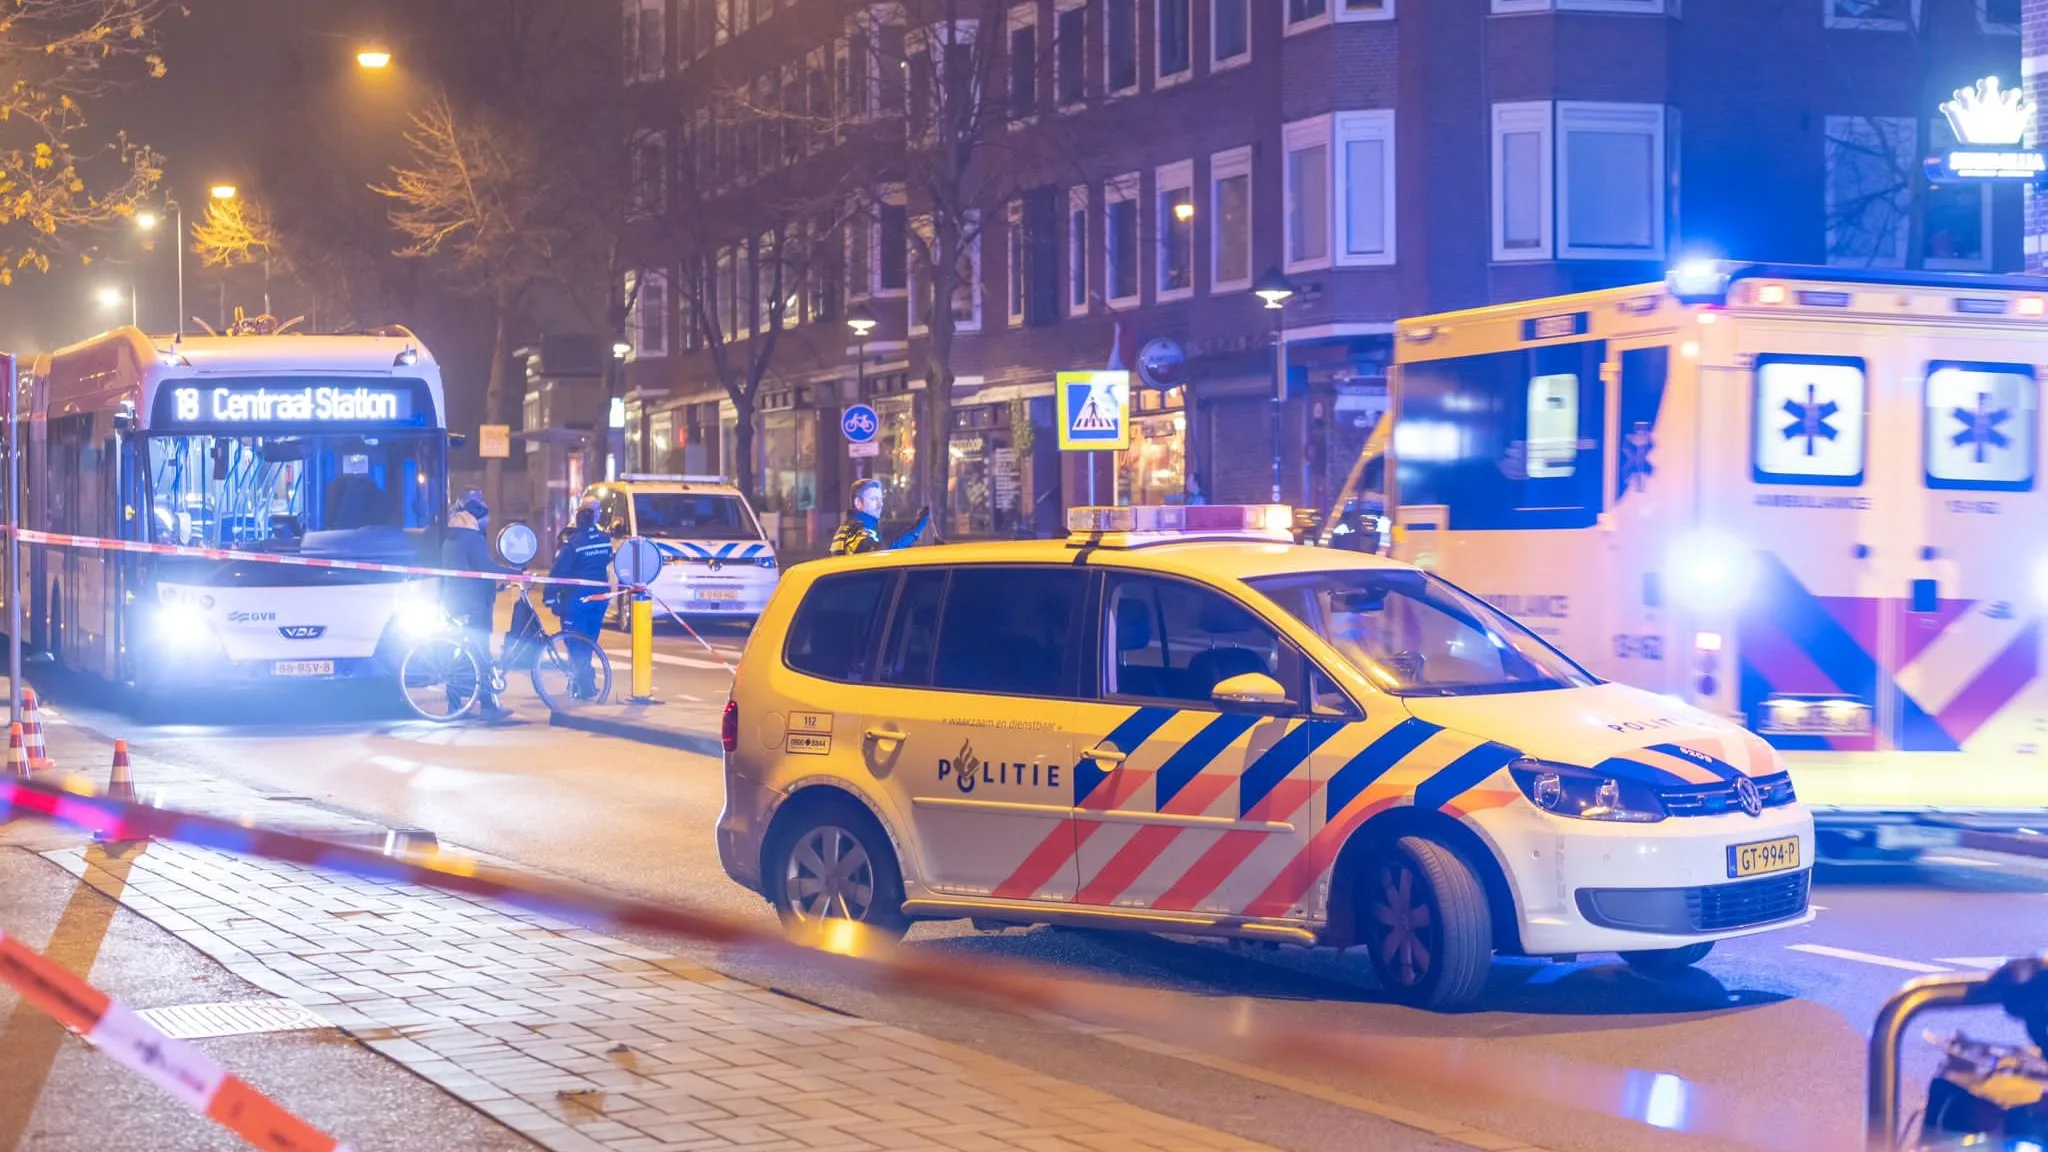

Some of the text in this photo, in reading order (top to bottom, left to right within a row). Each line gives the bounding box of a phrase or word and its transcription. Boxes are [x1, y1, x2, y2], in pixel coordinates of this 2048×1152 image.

[175, 387, 397, 420] 18 Centraal Station
[251, 612, 276, 621] GVB
[285, 626, 320, 637] VDL
[804, 716, 817, 726] 112
[938, 758, 1060, 793] POLITIE
[1742, 842, 1795, 871] GT-994-P
